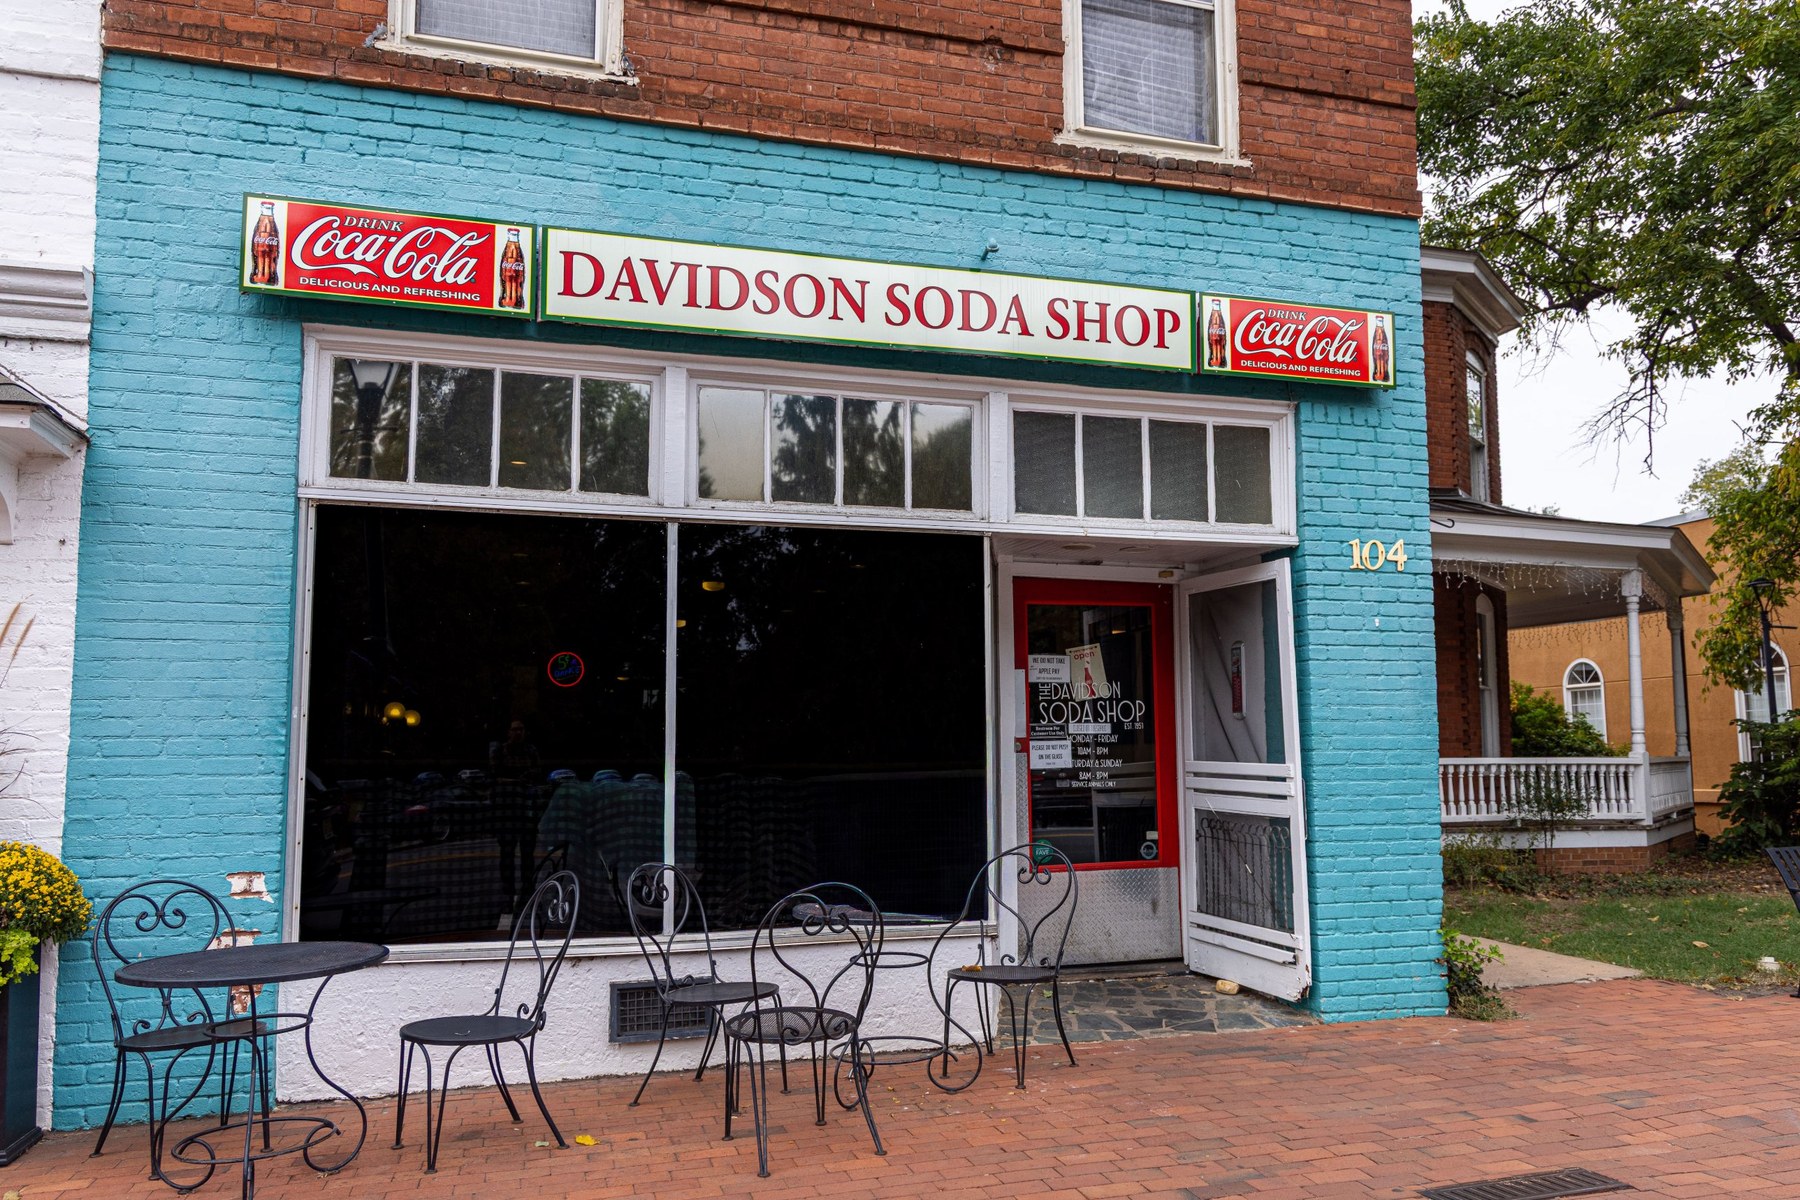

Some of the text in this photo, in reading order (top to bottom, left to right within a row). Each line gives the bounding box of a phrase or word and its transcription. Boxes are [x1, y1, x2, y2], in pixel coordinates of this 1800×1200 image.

[344, 215, 406, 232] DRINK
[290, 215, 491, 286] Coca-Cola
[299, 276, 481, 302] DELICIOUS AND REFRESHING
[557, 250, 1181, 350] DAVIDSON SODA SHOP
[1267, 308, 1308, 321] DRINK
[1234, 308, 1366, 364] Coca-Cola
[1240, 359, 1361, 377] DELICIOUS AND REFRESHING
[1348, 538, 1408, 572] 104
[1073, 651, 1095, 661] open
[1038, 667, 1051, 675] APPLE
[1038, 683, 1051, 701] THE
[1052, 680, 1121, 700] DAVIDSON
[1040, 700, 1146, 724] SODA SHOP
[1124, 722, 1133, 730] EST.
[1067, 735, 1093, 743] MONDAY
[1098, 734, 1118, 742] FRIDAY
[1078, 746, 1091, 755] 10AM
[1100, 759, 1122, 768] SUNDAY
[1079, 772, 1091, 780] 8AM
